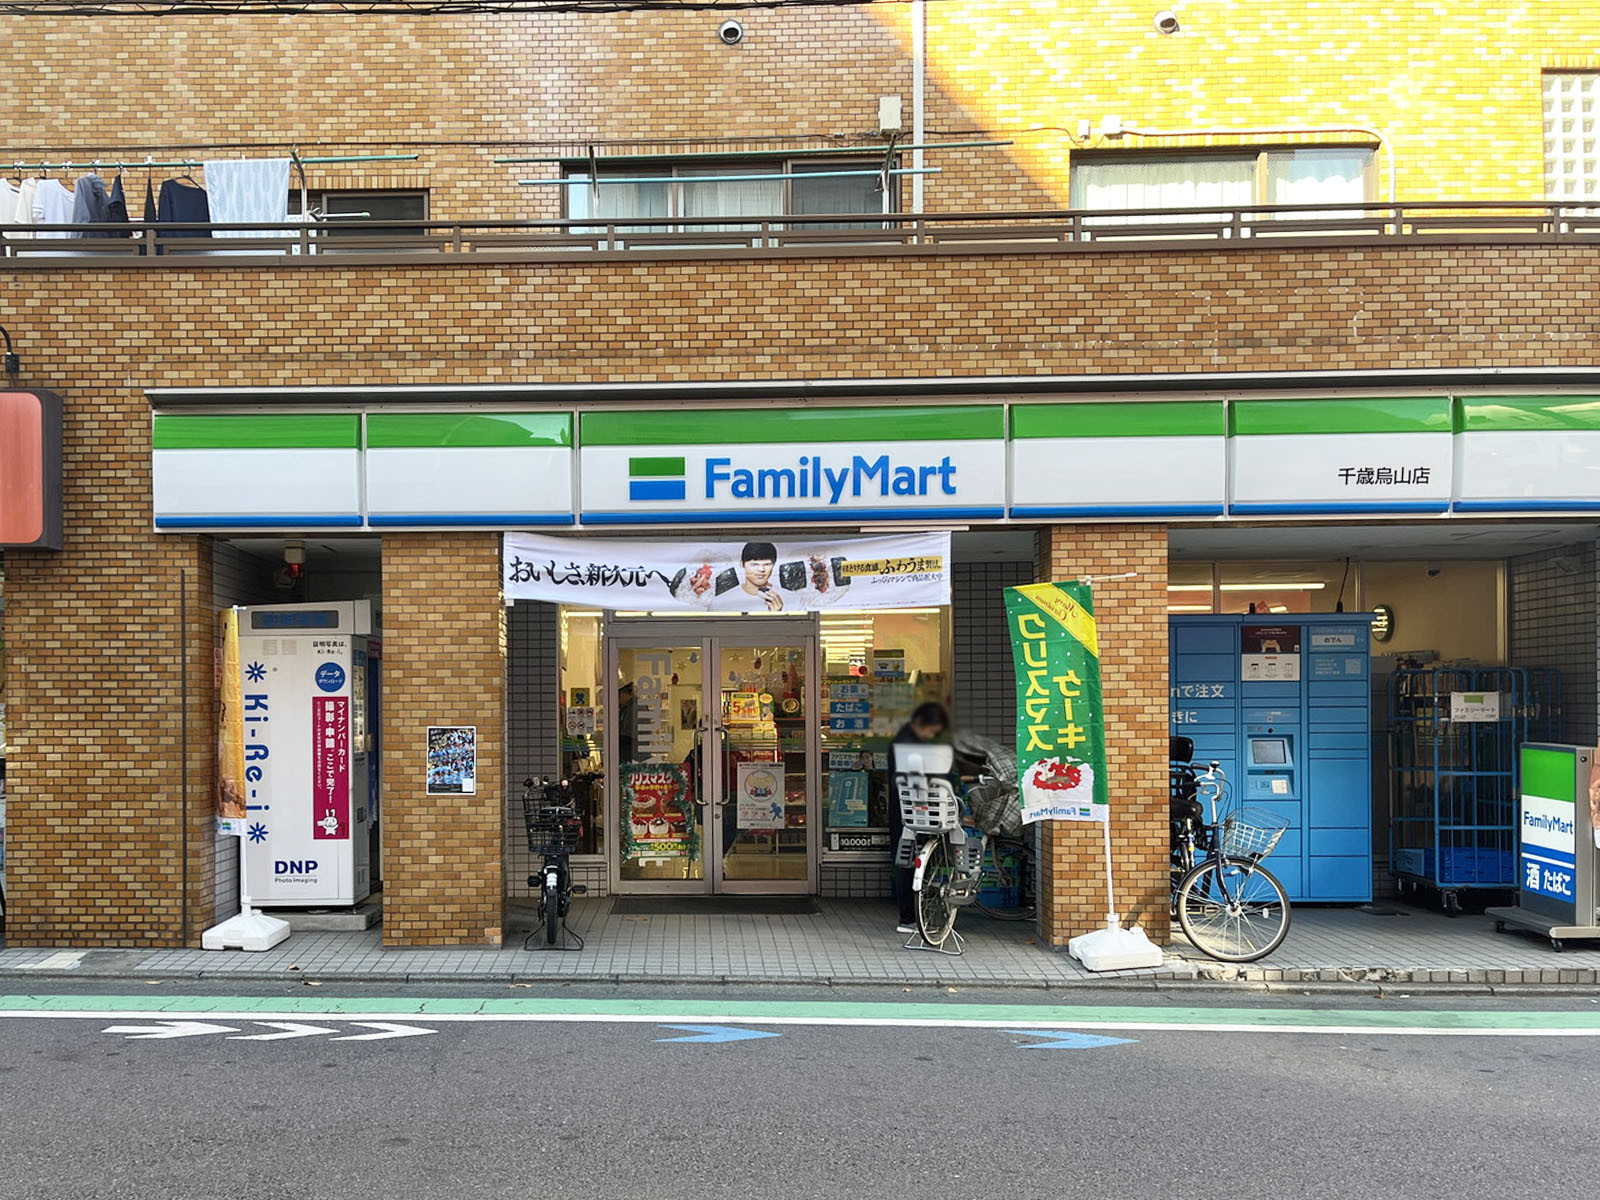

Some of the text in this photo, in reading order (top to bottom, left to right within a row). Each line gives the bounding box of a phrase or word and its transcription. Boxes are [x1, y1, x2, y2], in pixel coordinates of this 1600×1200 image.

[705, 456, 957, 504] FamilyMart
[1337, 466, 1431, 486] 千歳烏山店
[836, 703, 864, 713] たばこ
[336, 700, 346, 773] マイナンバーカード
[244, 694, 271, 811] Ki-Re-i
[1523, 811, 1574, 834] FamilyMart
[274, 860, 319, 875] DNP
[1526, 862, 1572, 896] 酒 たばこ
